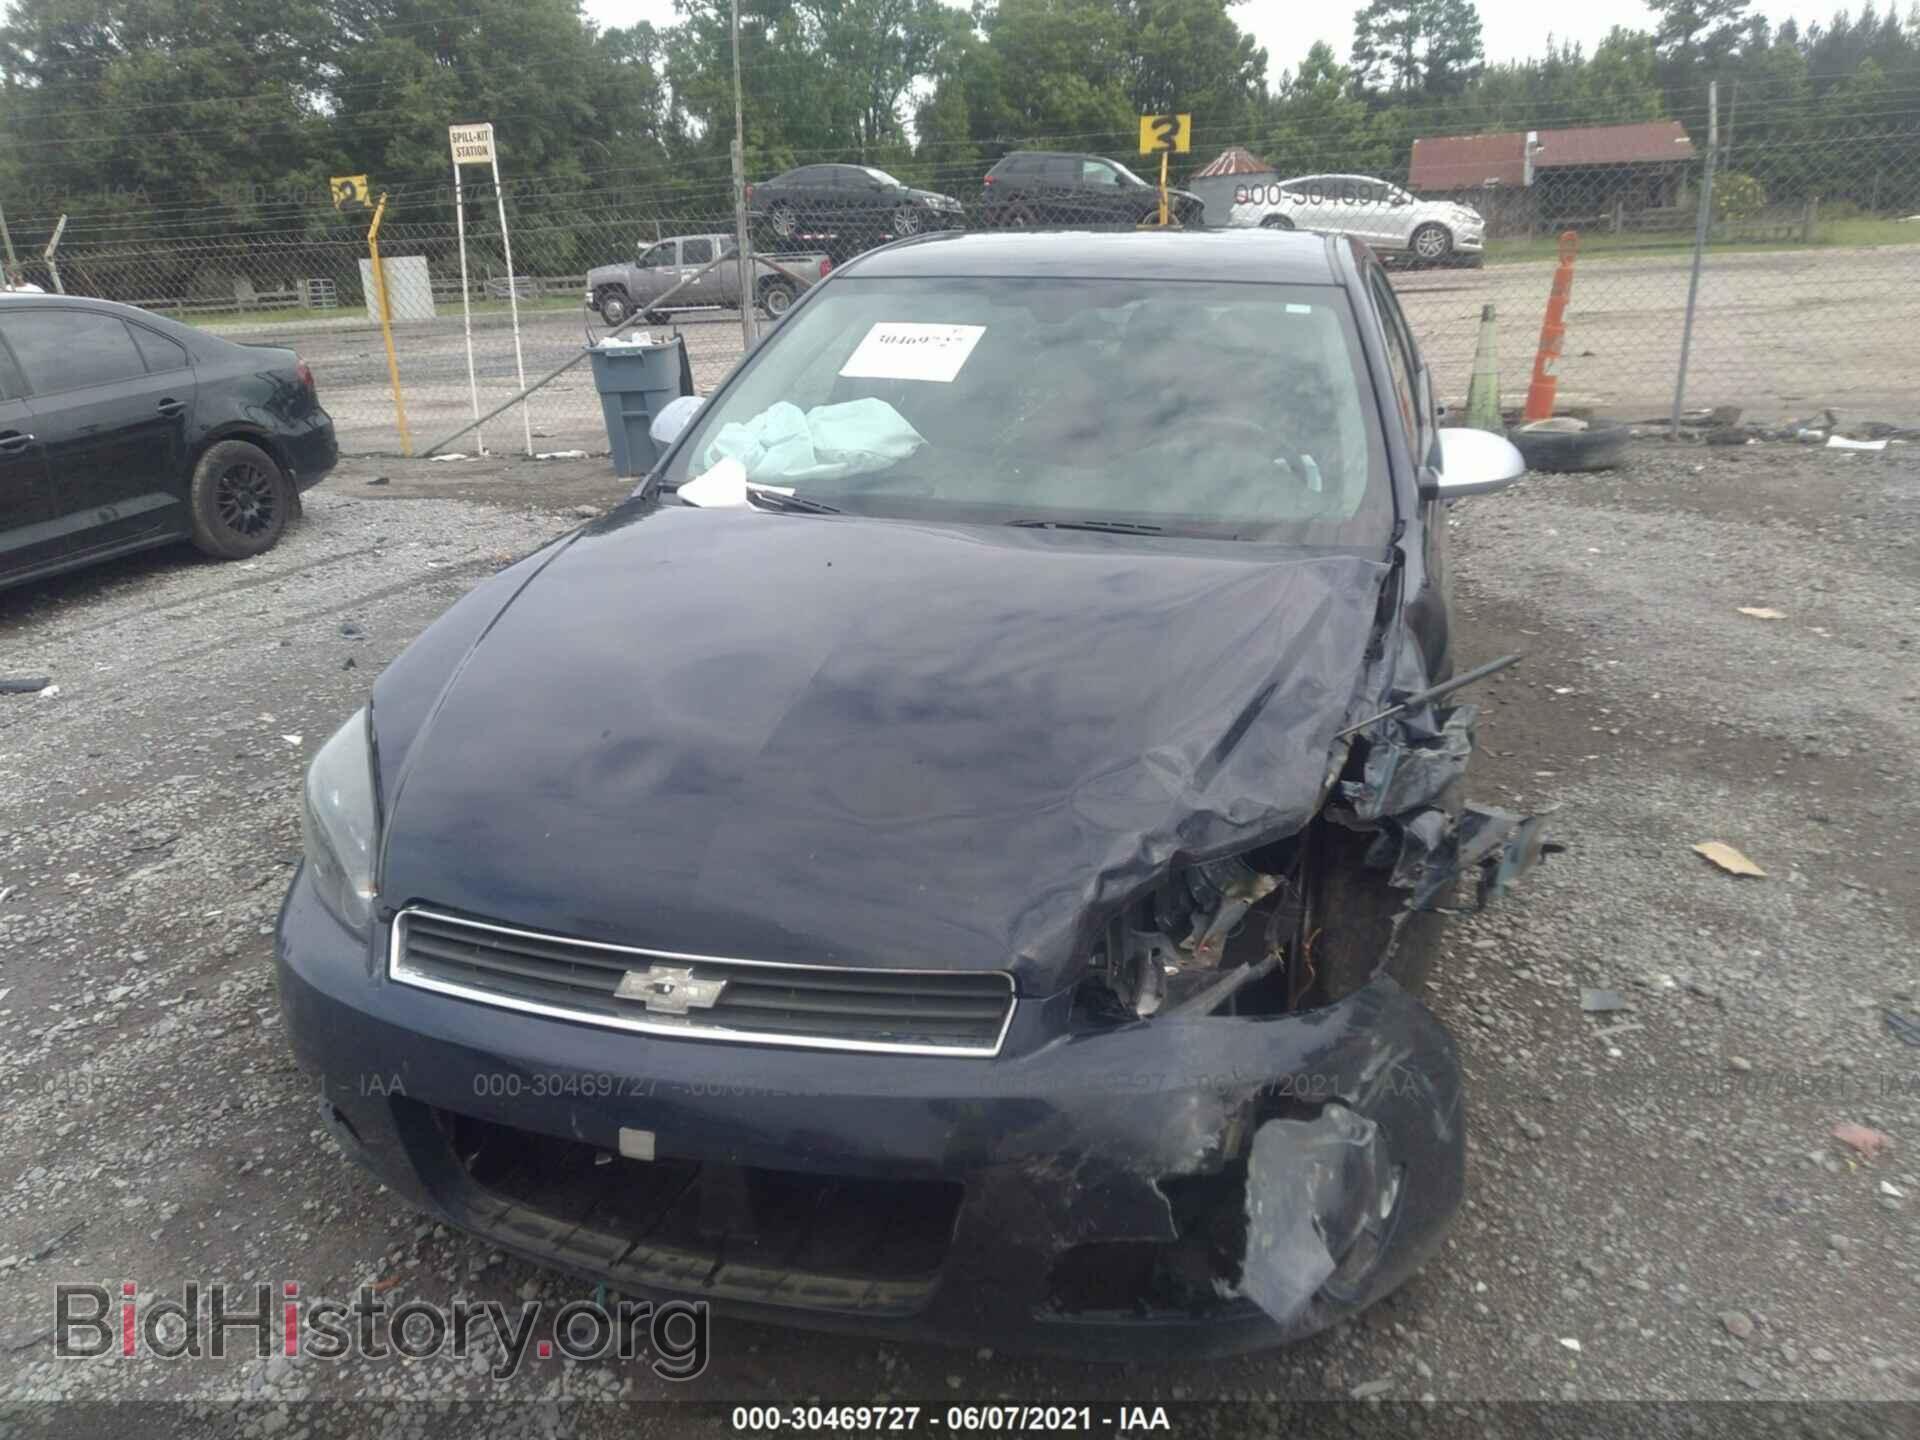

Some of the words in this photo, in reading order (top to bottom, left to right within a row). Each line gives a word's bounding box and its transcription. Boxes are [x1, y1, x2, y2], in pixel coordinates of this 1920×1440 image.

[451, 130, 489, 144] SPILL-KIT
[1151, 115, 1181, 152] 3
[456, 144, 489, 158] STATION
